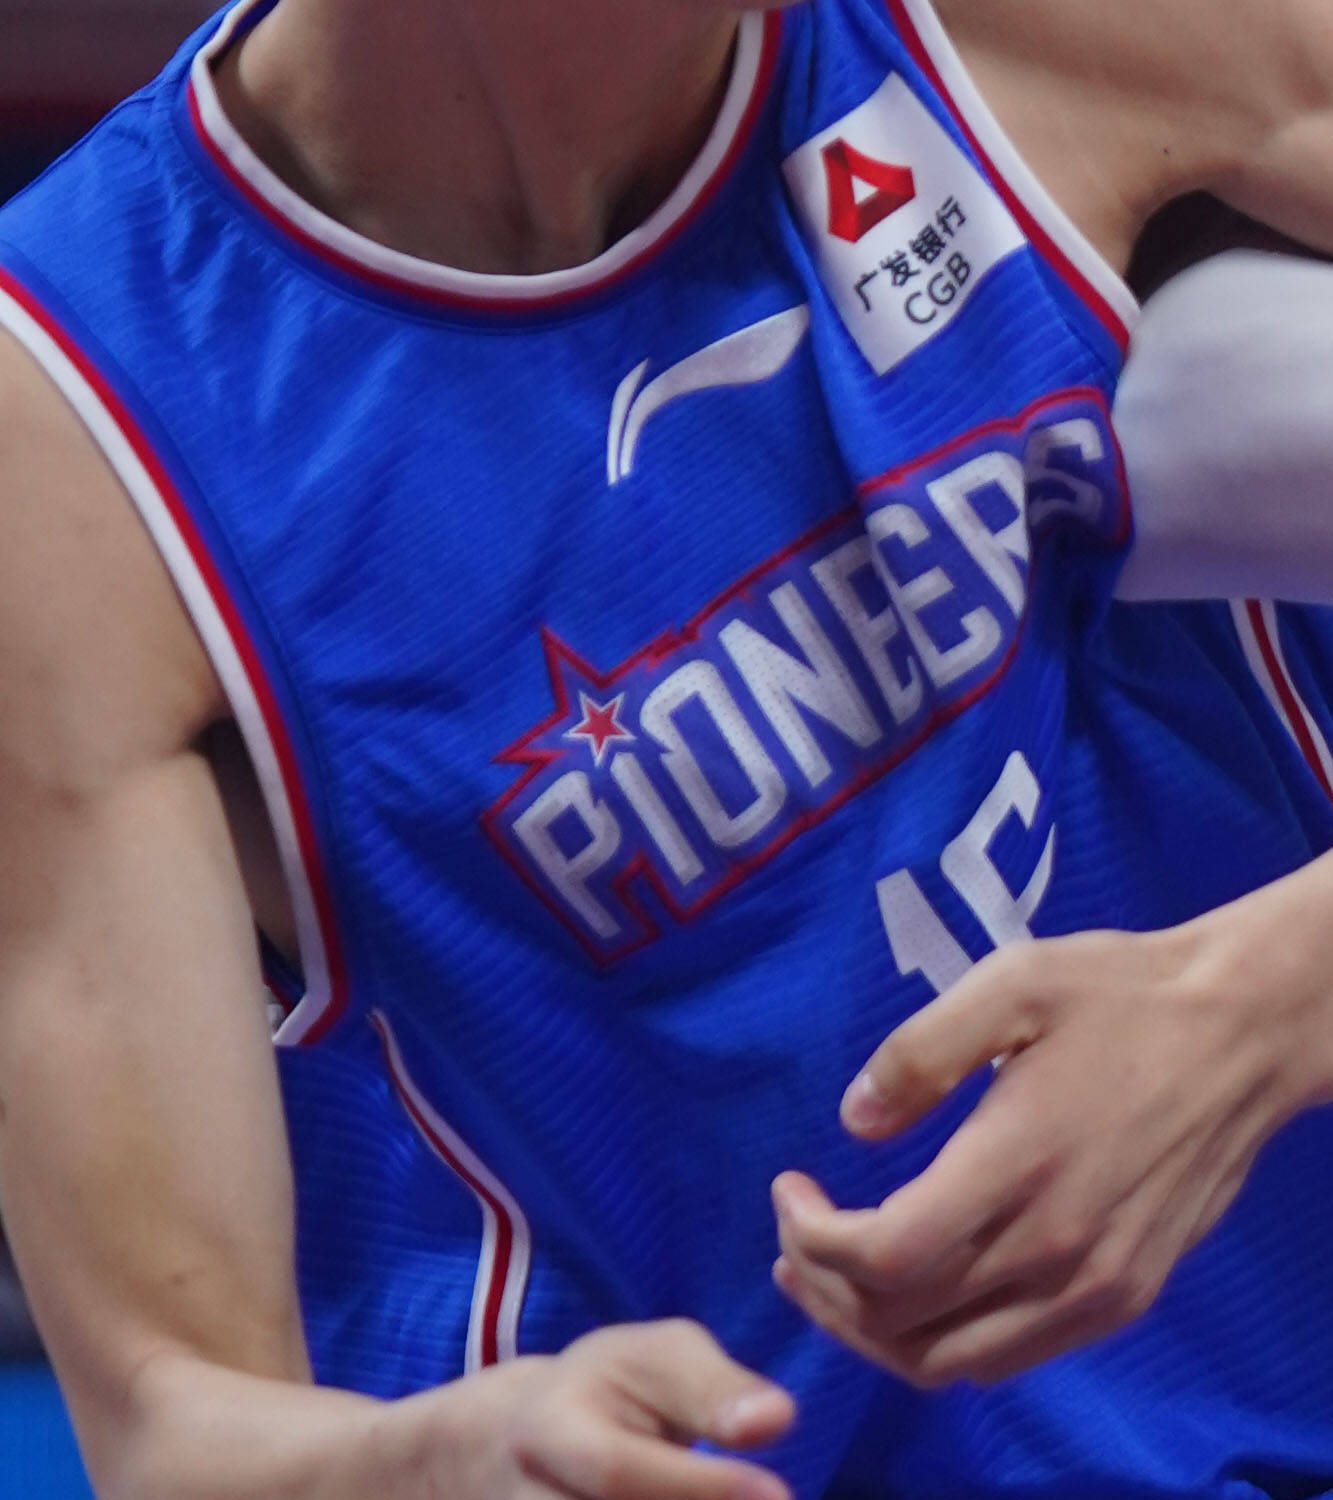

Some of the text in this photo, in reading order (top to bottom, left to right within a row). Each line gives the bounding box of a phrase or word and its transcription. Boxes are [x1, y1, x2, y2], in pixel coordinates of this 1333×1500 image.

[855, 194, 967, 314] 广发银行
[903, 250, 971, 325] CGB
[511, 417, 1106, 941] PIONEERS
